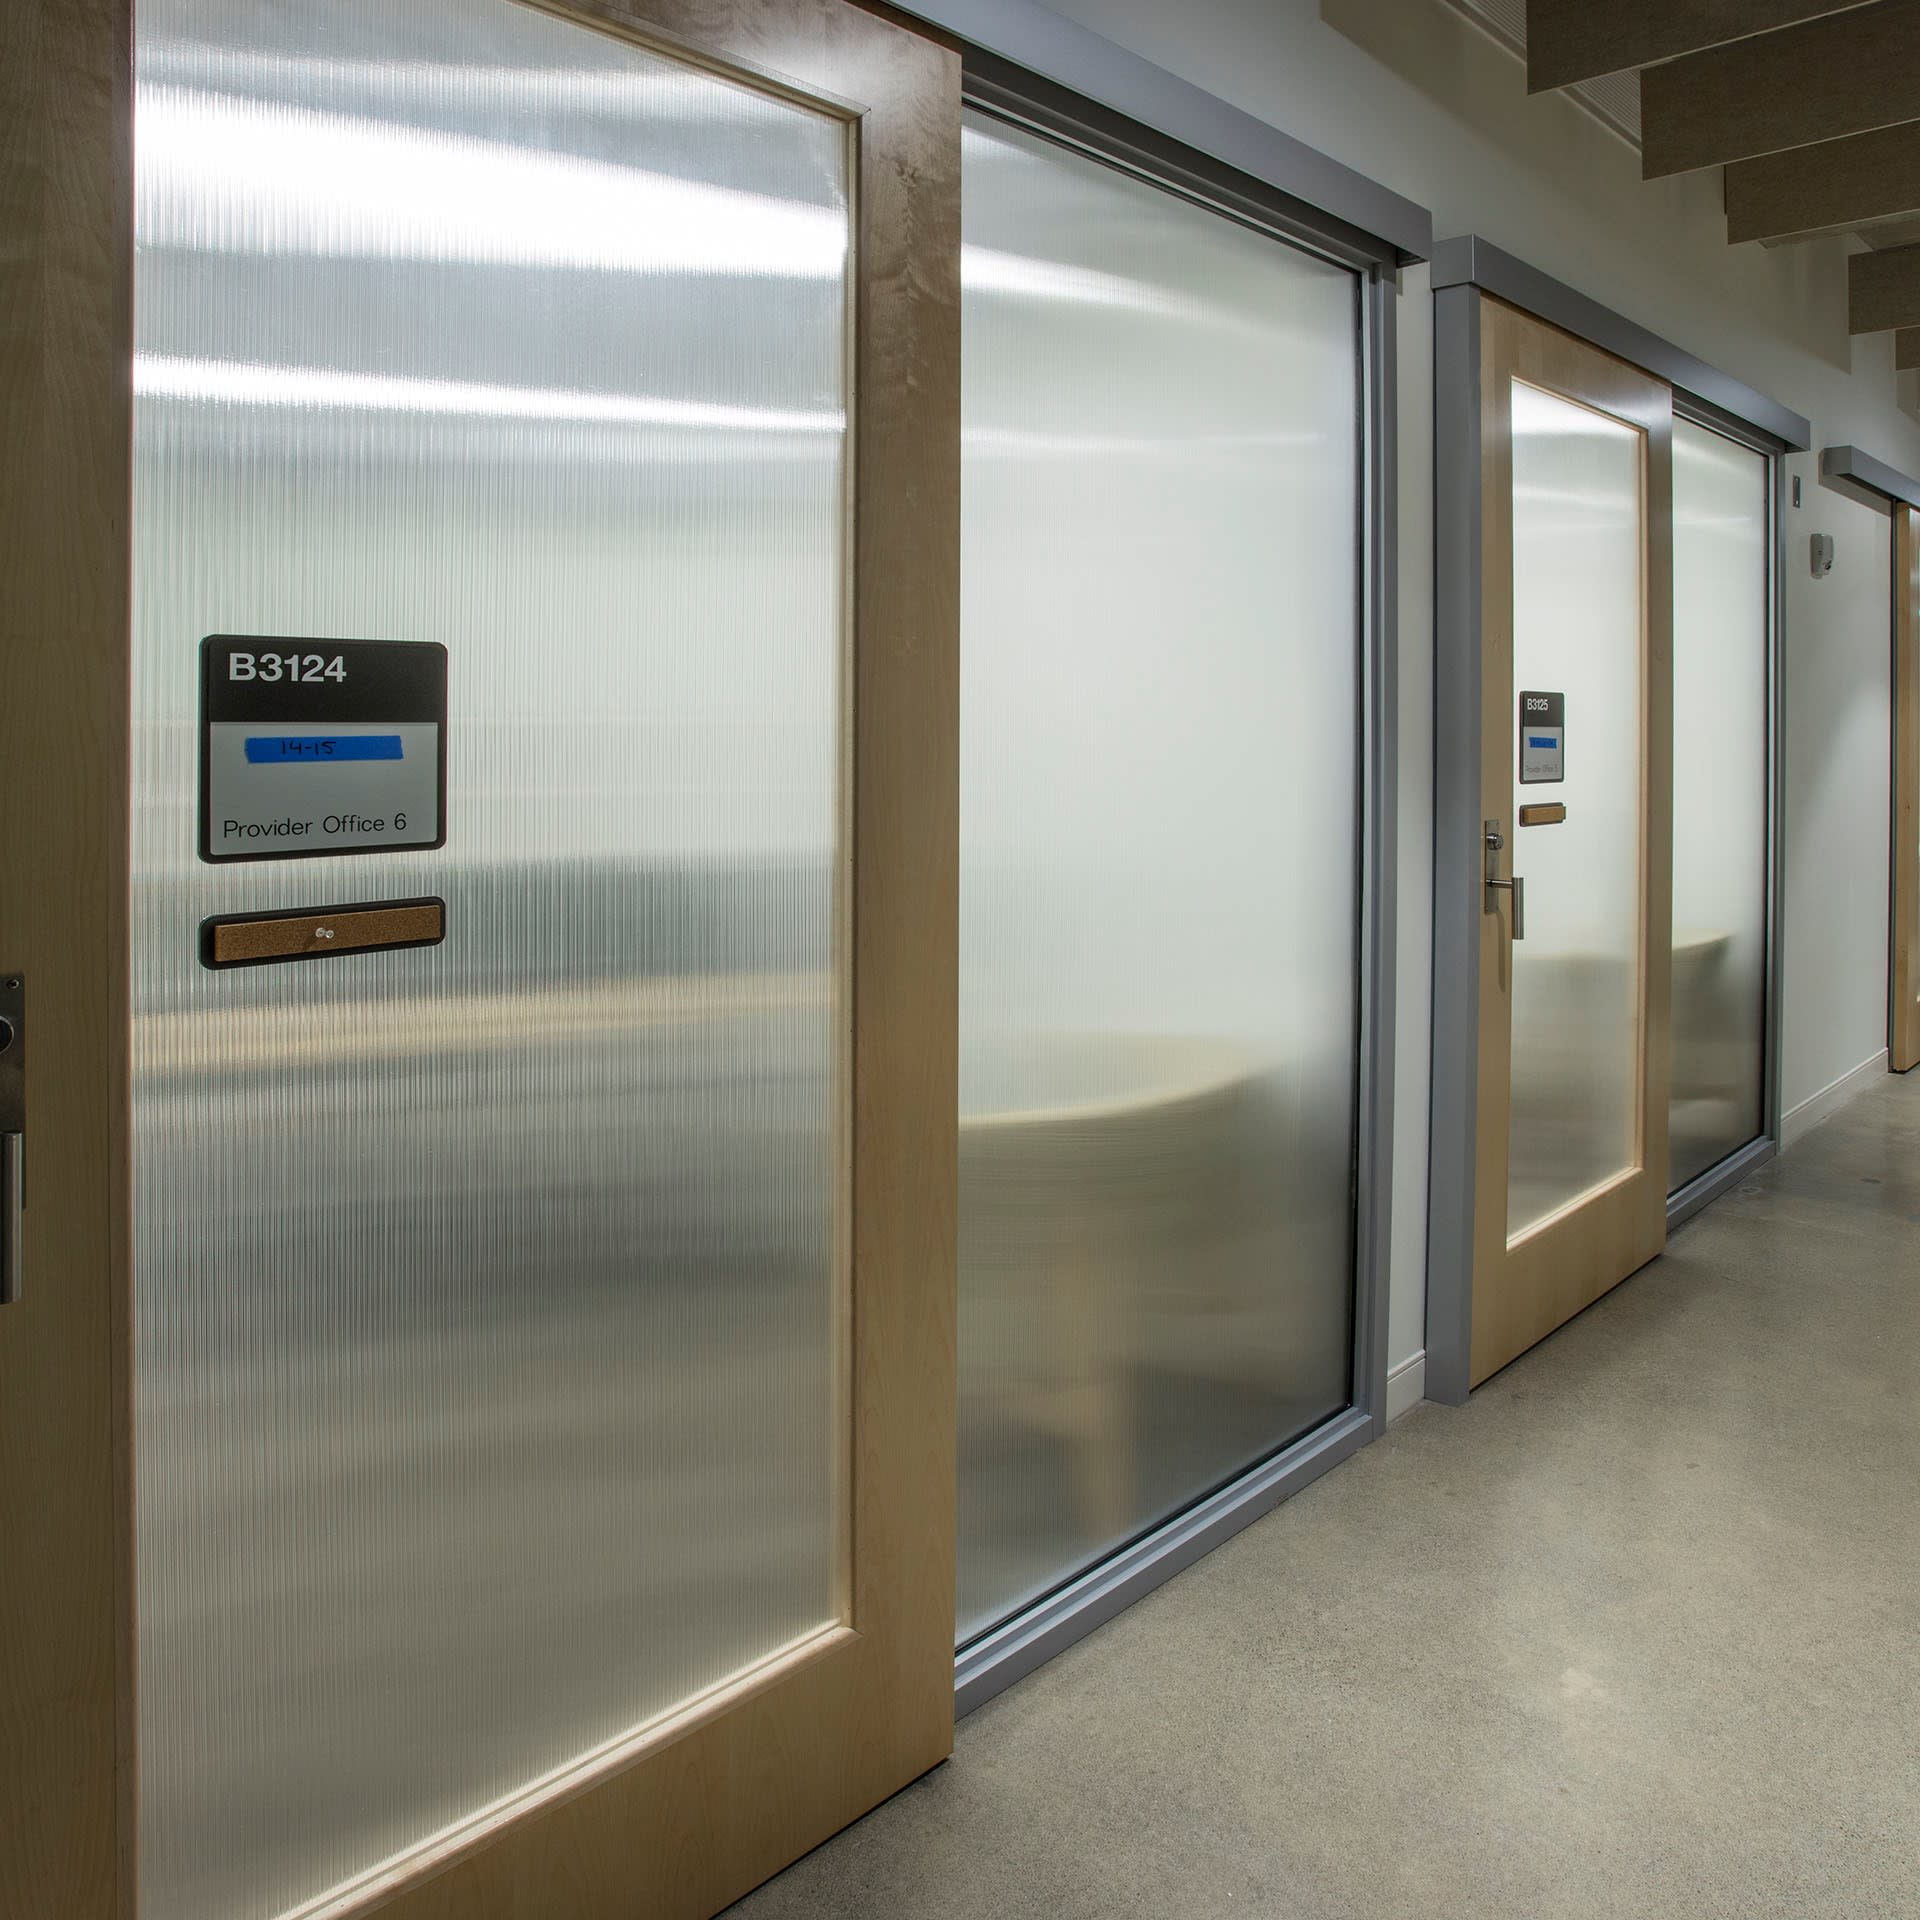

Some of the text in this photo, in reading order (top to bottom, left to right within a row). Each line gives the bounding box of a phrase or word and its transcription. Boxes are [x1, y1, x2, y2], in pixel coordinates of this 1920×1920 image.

[229, 653, 347, 682] B3124
[1527, 699, 1548, 711] B3125
[281, 741, 337, 755] 14-15
[223, 813, 407, 839] Provider Office 6
